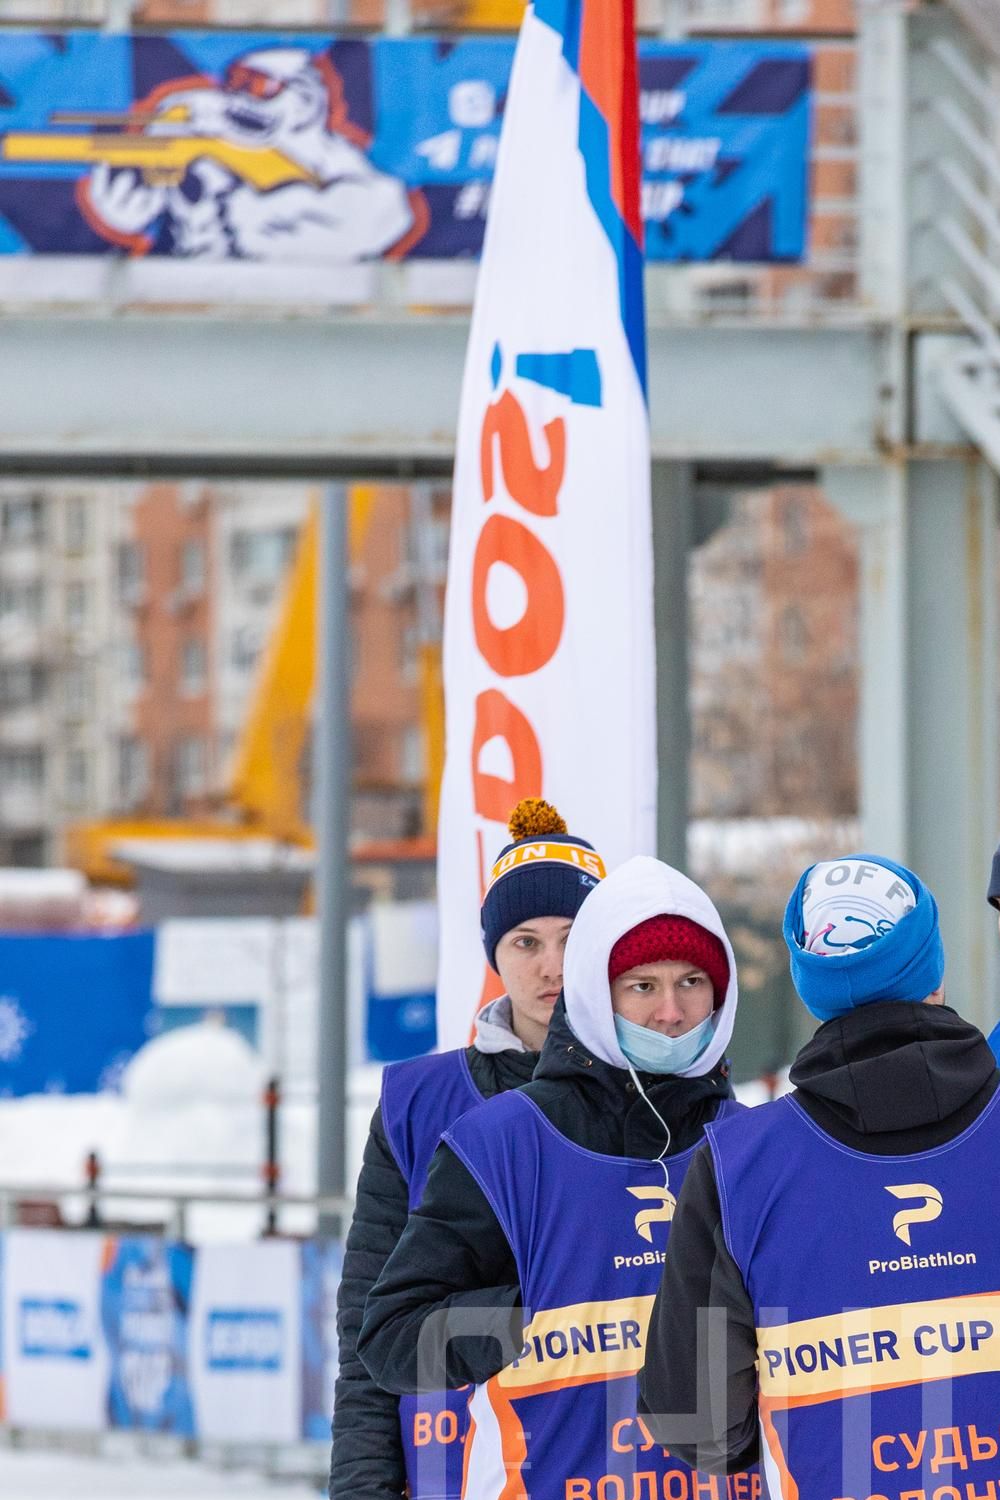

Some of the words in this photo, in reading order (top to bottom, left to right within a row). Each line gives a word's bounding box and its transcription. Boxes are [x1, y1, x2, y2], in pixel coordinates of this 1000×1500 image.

[613, 1250, 667, 1270] ProBia
[868, 1250, 978, 1275] ProBiathlon
[763, 1329, 900, 1379] PIONER
[912, 1319, 994, 1357] CUP
